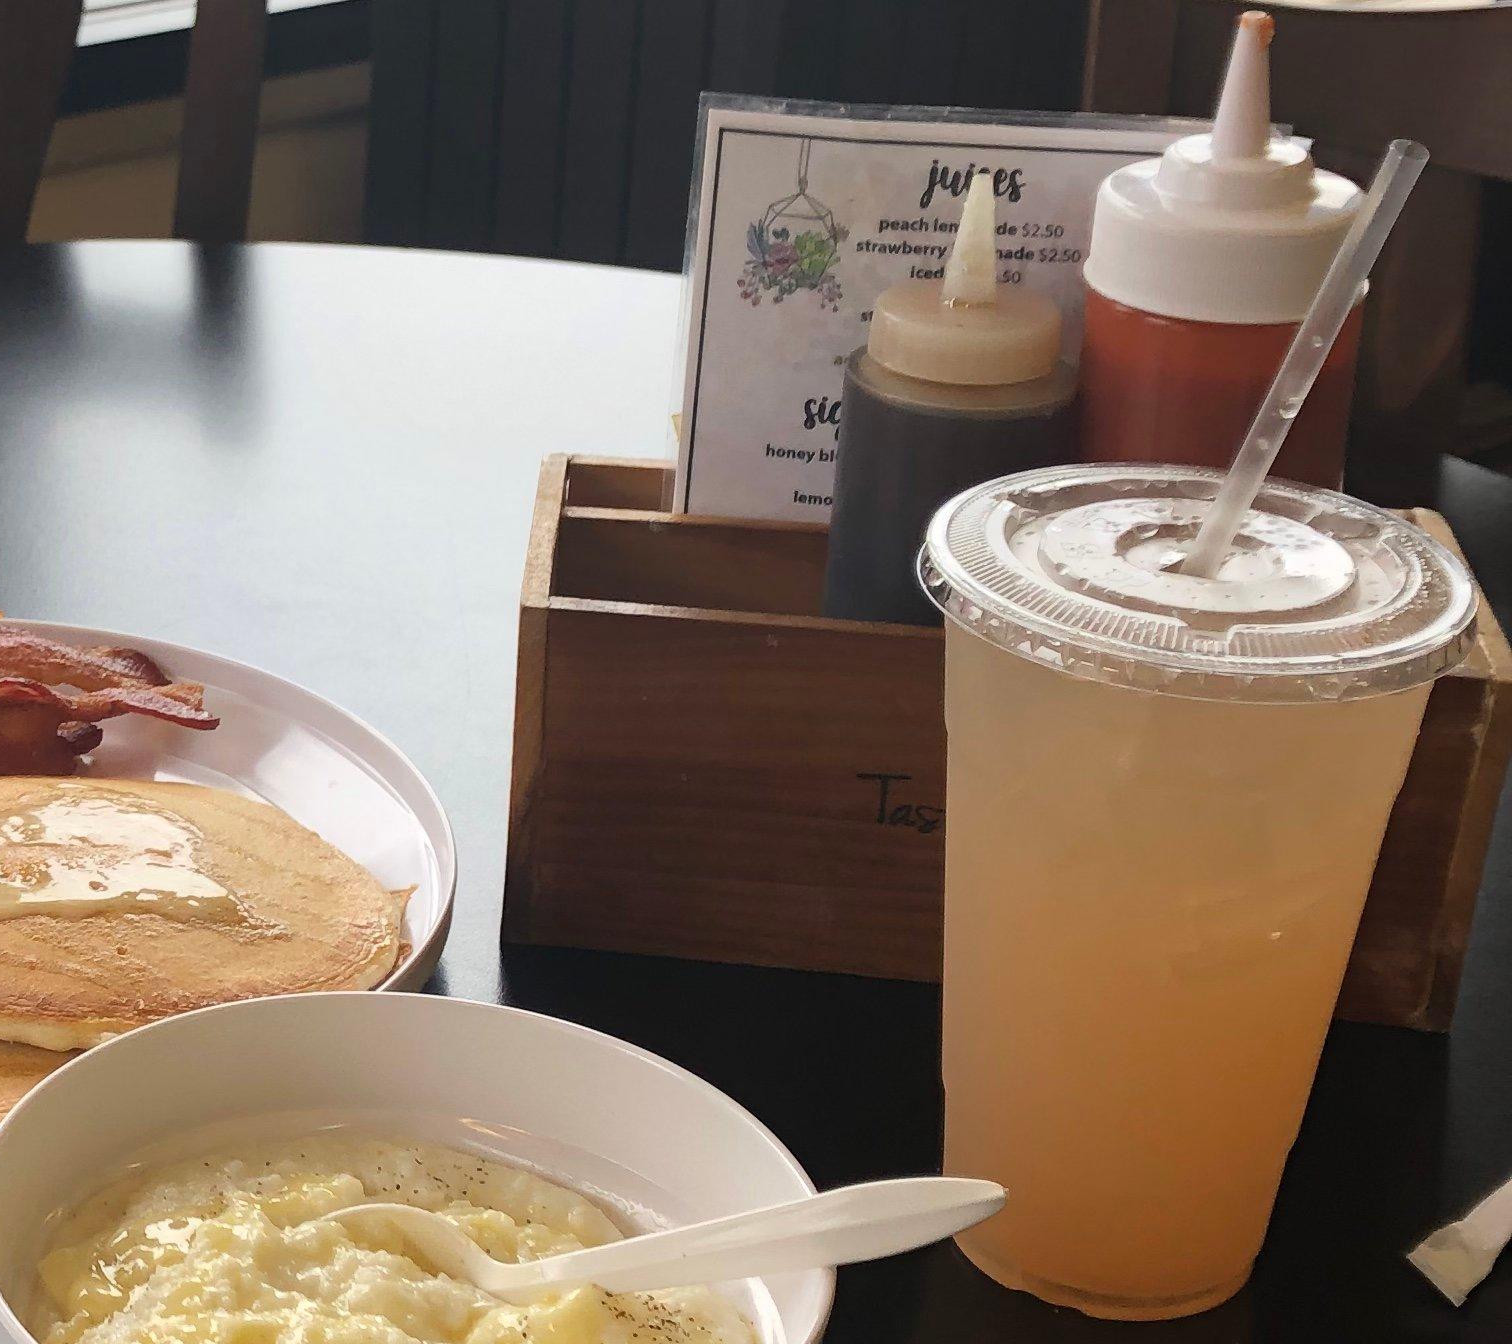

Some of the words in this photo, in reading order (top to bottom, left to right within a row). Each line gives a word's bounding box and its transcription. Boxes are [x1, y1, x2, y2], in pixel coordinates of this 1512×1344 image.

[919, 159, 1027, 208] juies
[878, 216, 931, 234] peach
[933, 218, 1018, 236] lemde
[1022, 223, 1065, 239] $2.50
[856, 240, 948, 258] strawberry
[1039, 247, 1082, 263] $2.50
[910, 265, 945, 280] iced
[765, 443, 815, 463] honey
[793, 490, 834, 506] lemo
[855, 771, 947, 834] Tas
